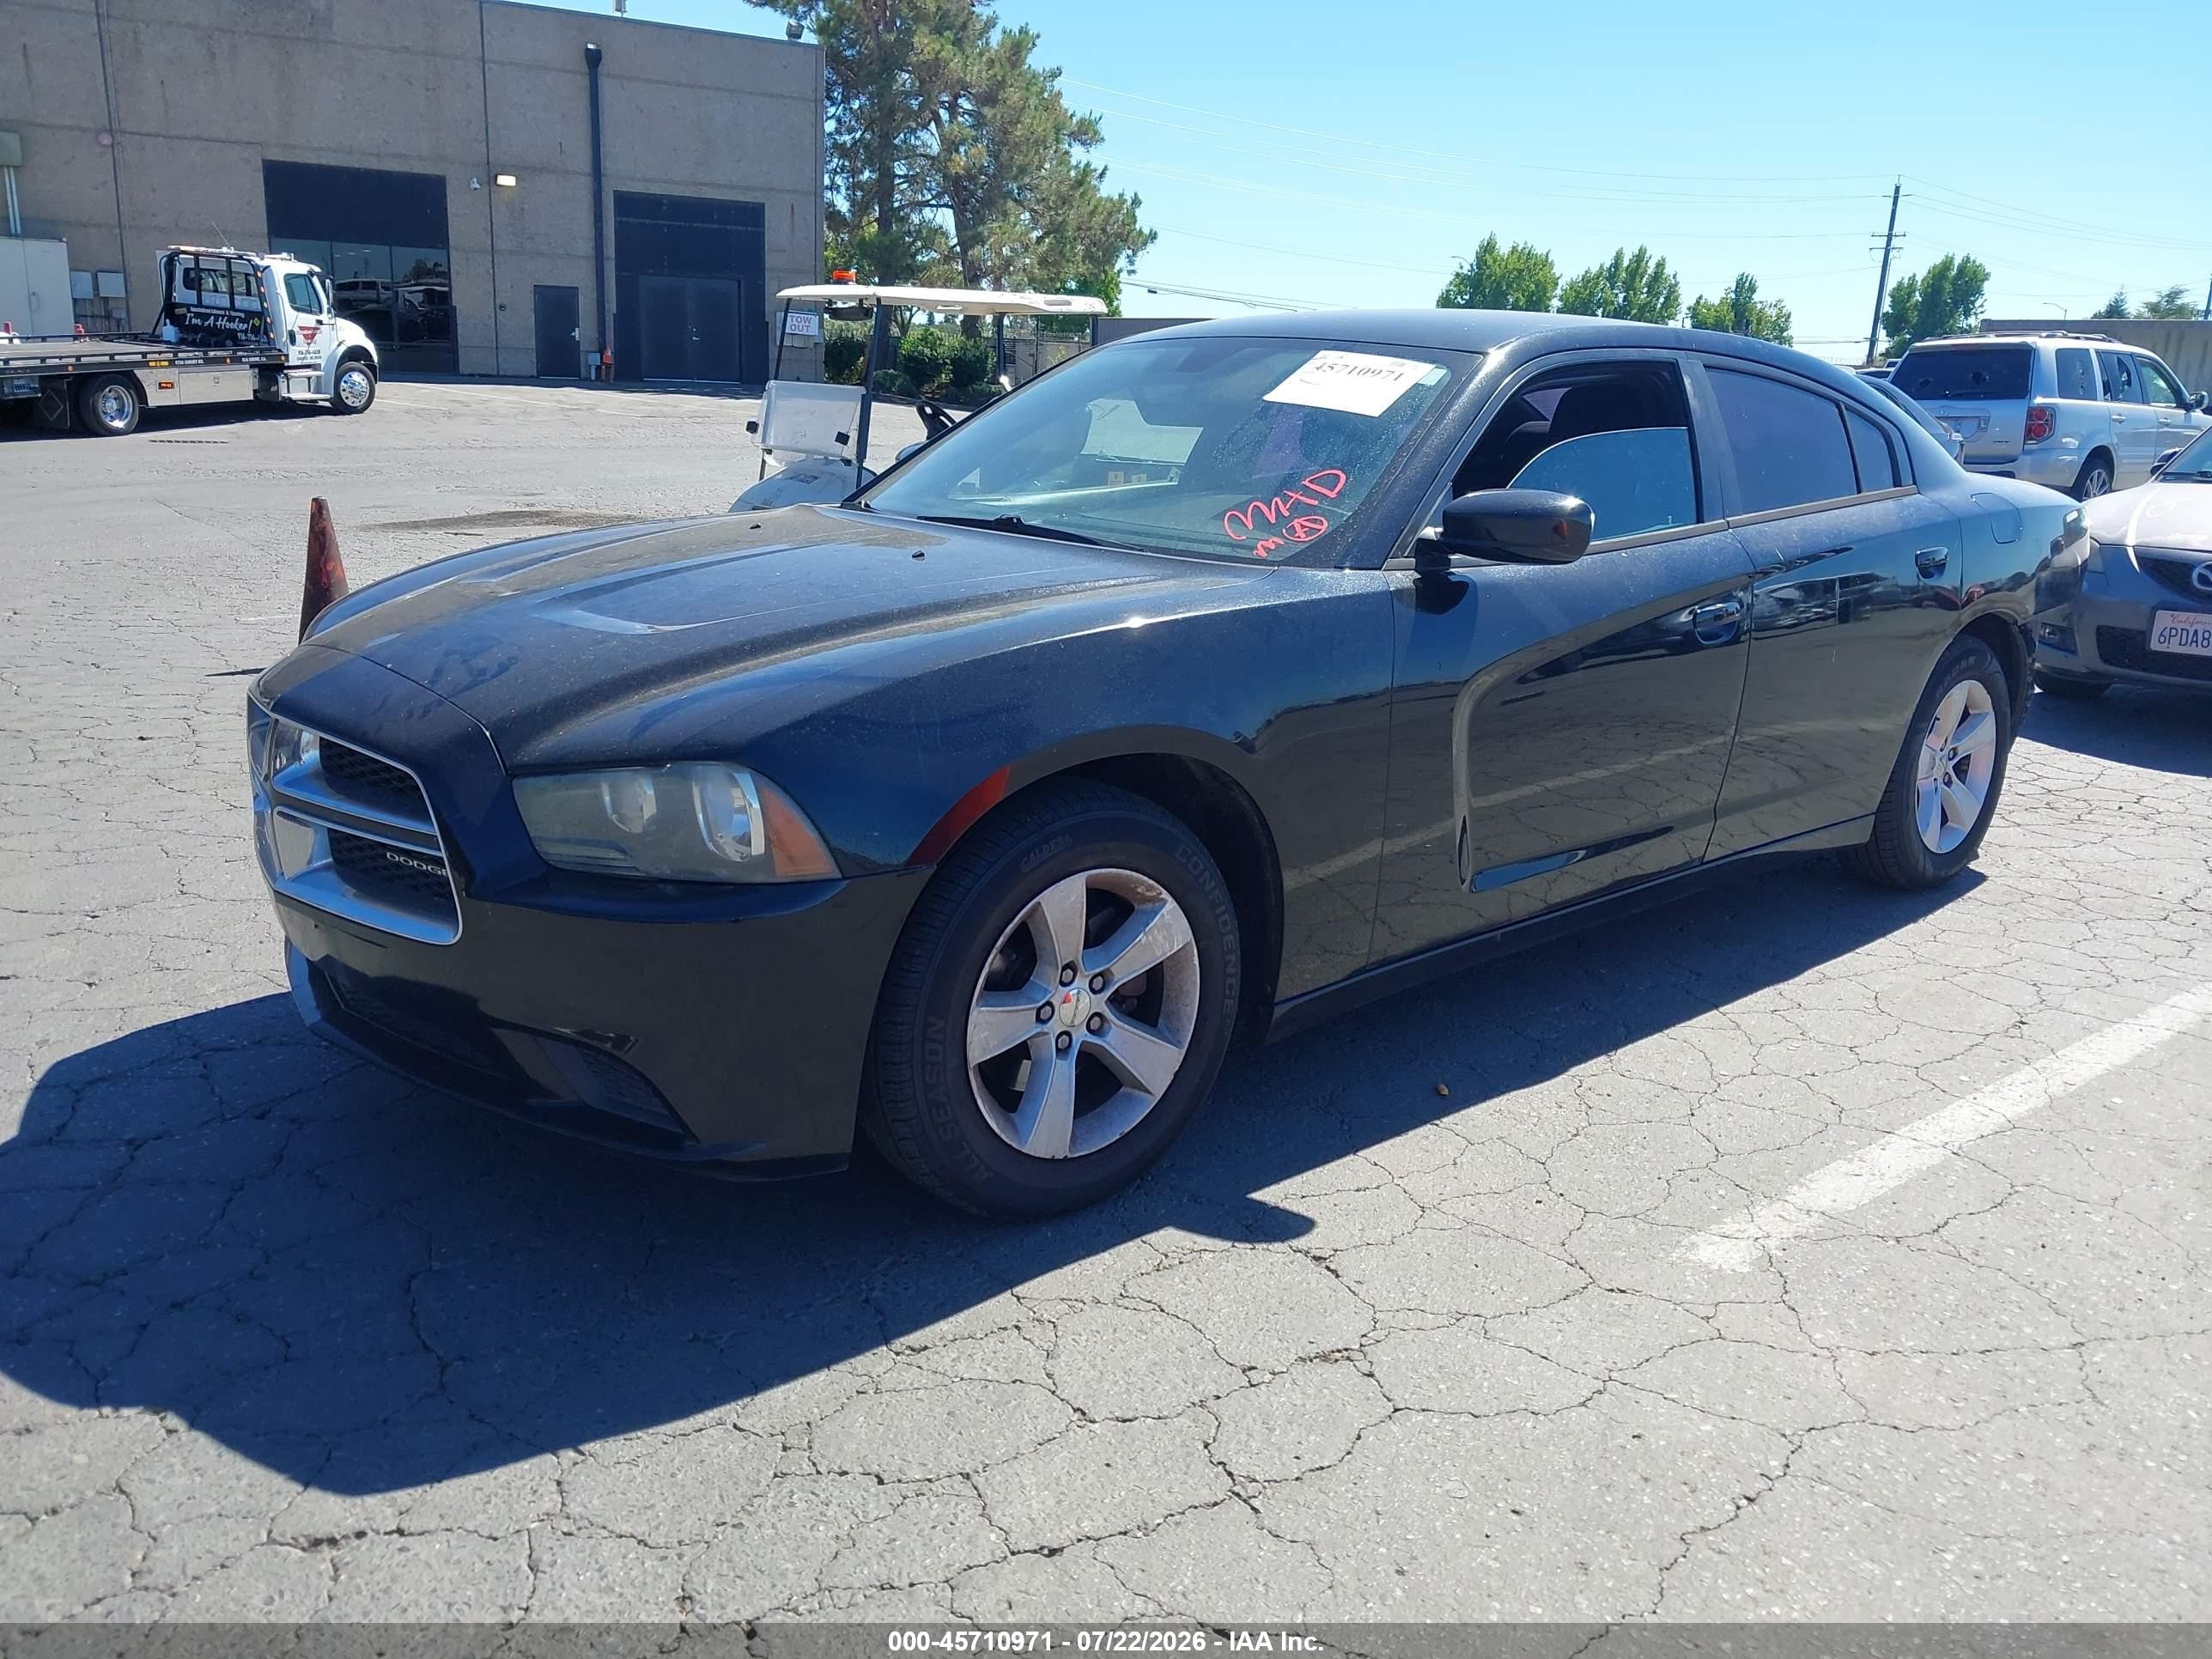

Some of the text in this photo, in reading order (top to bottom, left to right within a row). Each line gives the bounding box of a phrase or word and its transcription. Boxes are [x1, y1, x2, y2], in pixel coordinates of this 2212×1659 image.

[204, 316, 214, 327] A
[790, 315, 811, 324] TOW
[791, 324, 811, 332] OUT
[1314, 362, 1405, 381] 45710971
[2158, 626, 2212, 648] 6PDA8
[1175, 844, 1237, 1012] CONFIDENCE
[925, 1016, 960, 1141] SEASON
